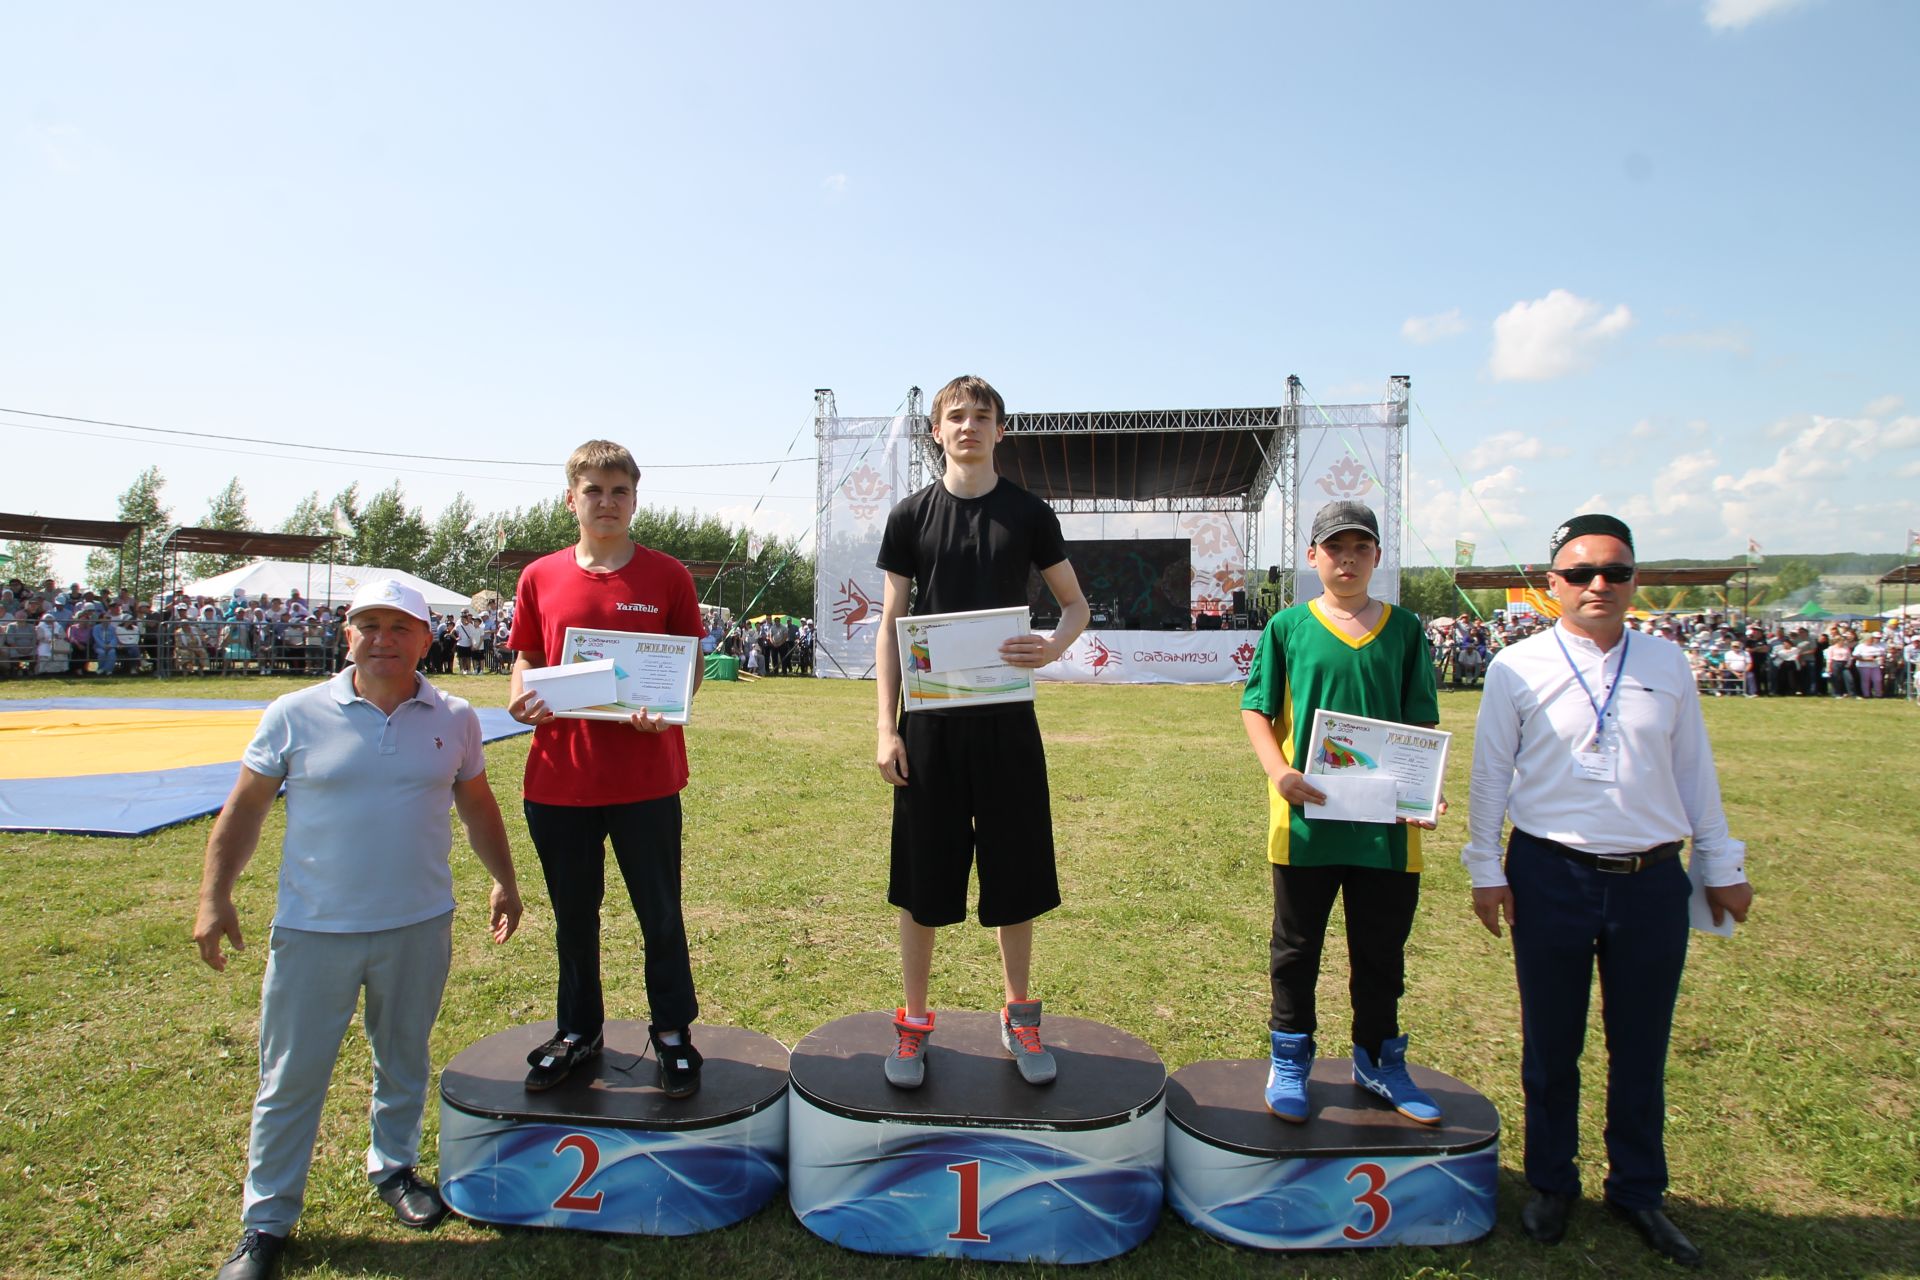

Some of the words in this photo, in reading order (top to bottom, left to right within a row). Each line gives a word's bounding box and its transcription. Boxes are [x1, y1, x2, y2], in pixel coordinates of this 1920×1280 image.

[636, 642, 686, 655] ДИПЛОМ
[1133, 651, 1218, 664] Сабантуй
[1386, 732, 1439, 751] ДИПЛОМ
[552, 1133, 604, 1213] 2
[946, 1160, 991, 1243] 1
[1342, 1163, 1391, 1241] 3
